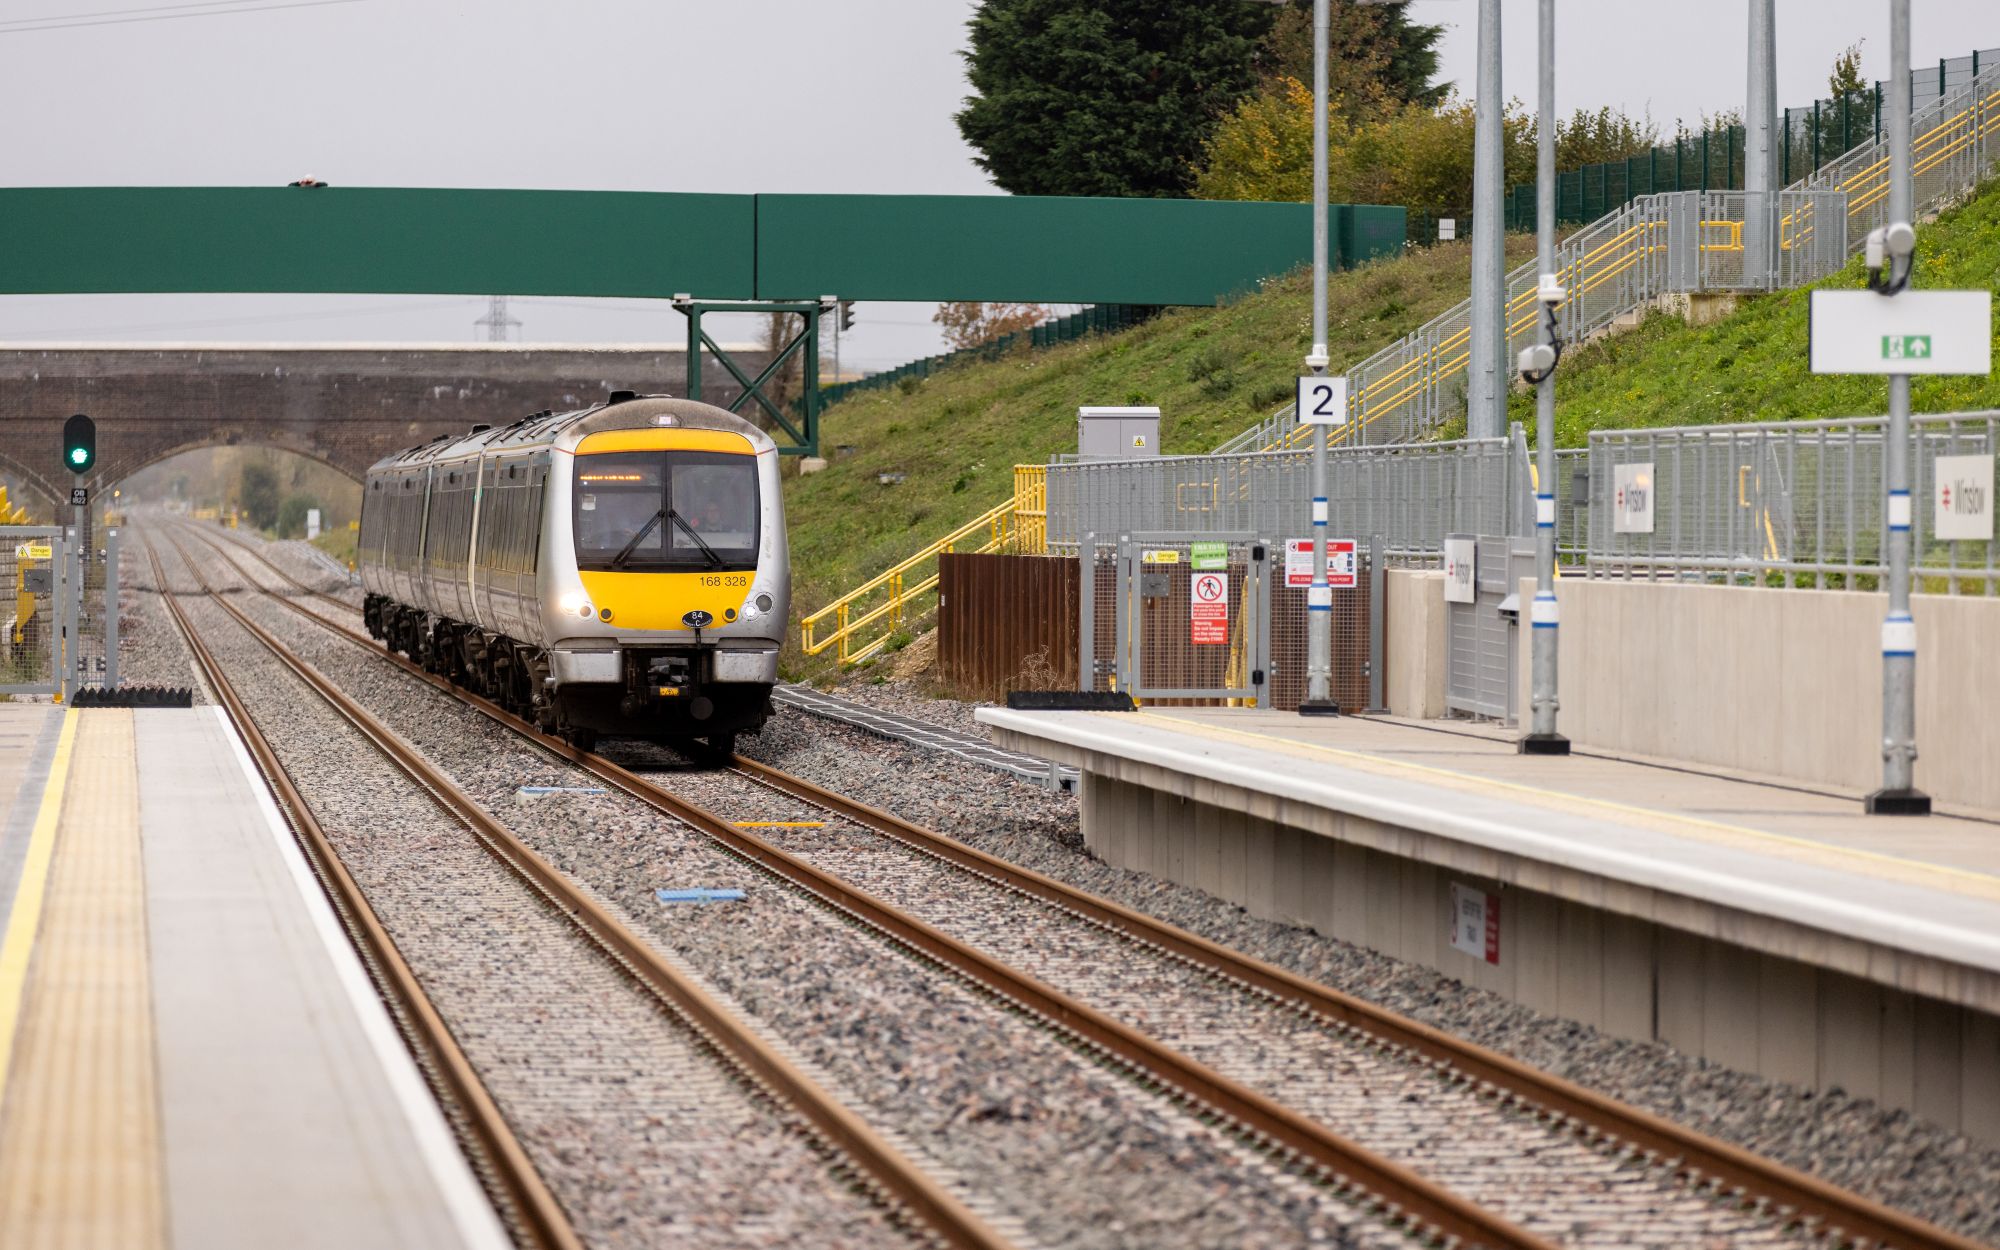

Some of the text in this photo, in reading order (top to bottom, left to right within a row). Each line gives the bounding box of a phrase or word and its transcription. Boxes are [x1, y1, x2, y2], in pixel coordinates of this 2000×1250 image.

[1312, 384, 1333, 416] 2
[1954, 478, 1985, 515] Winslow
[699, 576, 746, 586] 168 328
[691, 611, 703, 620] 84
